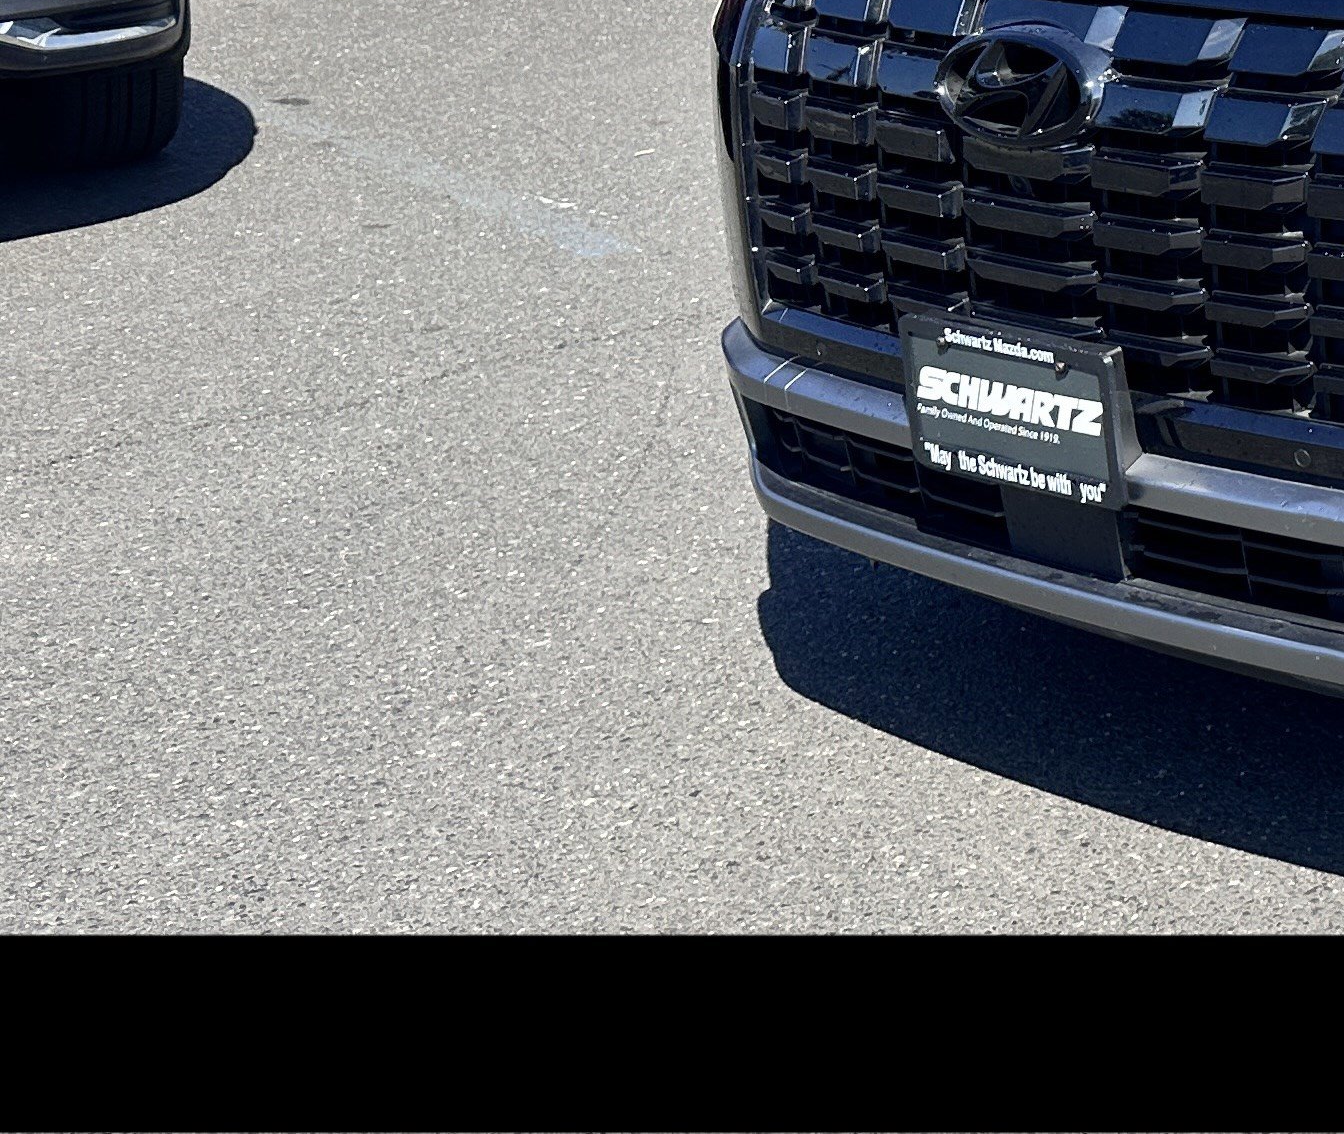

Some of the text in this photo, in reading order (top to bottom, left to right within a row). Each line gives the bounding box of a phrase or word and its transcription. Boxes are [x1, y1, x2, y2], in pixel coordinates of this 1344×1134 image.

[944, 327, 1055, 364] Schwartz Mazda.com
[916, 365, 1104, 437] SCHWARTZ
[941, 407, 968, 424] Owned
[967, 414, 983, 427] And
[983, 418, 1018, 435] Operated
[1017, 425, 1039, 440] Since
[957, 450, 978, 473] the
[977, 454, 1031, 486] Schwartz
[1029, 466, 1046, 490] be
[1046, 472, 1073, 496] with
